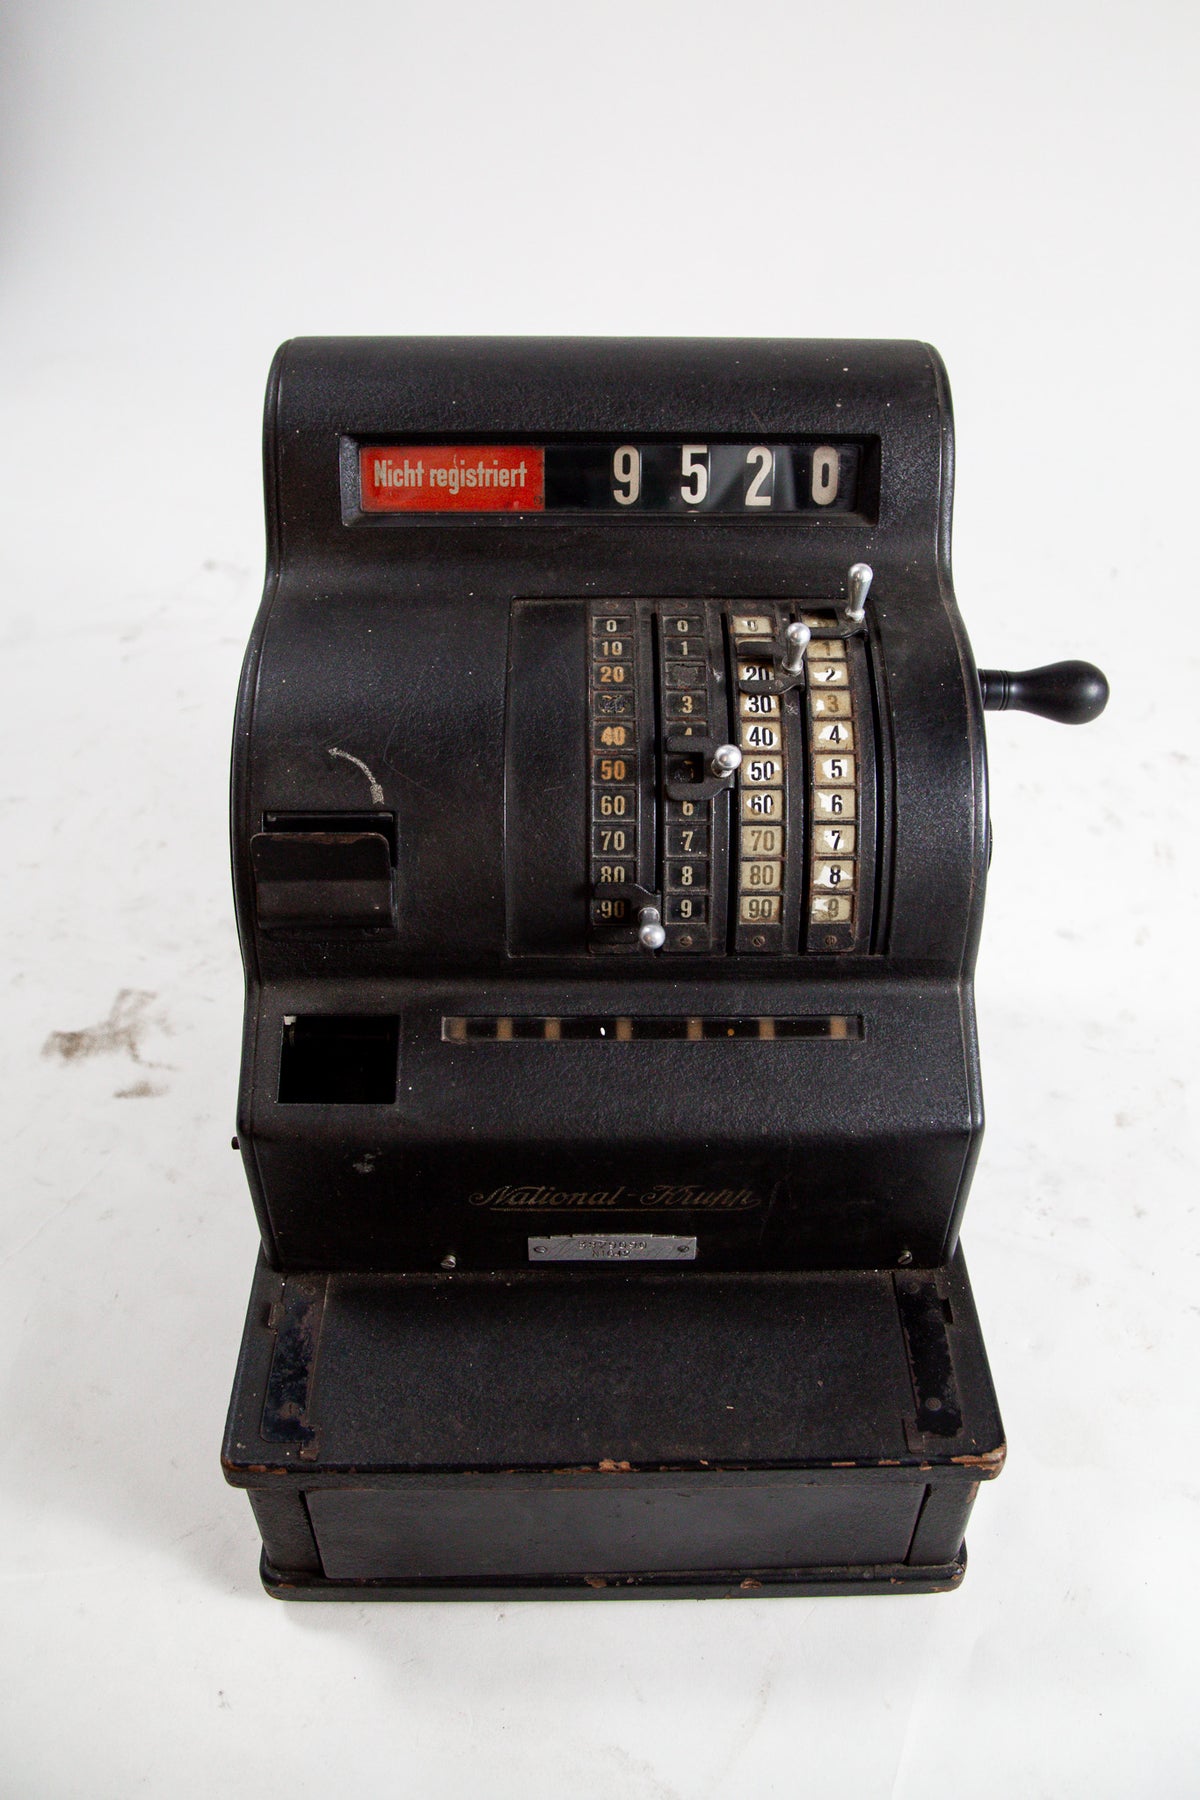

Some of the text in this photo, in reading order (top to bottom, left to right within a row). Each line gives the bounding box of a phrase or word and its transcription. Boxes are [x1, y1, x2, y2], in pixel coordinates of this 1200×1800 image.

[374, 459, 528, 494] Nicht registriert
[613, 445, 839, 506] 9 5 2 0
[606, 619, 617, 632] 0
[676, 619, 688, 632] 0
[601, 641, 623, 656] 10
[680, 640, 688, 656] 1
[600, 666, 624, 683] 20
[745, 666, 770, 681] 20
[825, 666, 837, 683] 2
[682, 695, 693, 714] 3
[748, 695, 772, 714] 30
[827, 695, 839, 713] 3
[600, 726, 626, 746] 40
[749, 727, 774, 747] 40
[829, 725, 841, 745] 4
[601, 760, 626, 780] 50
[750, 760, 775, 781] 50
[831, 759, 842, 780] 5
[600, 795, 626, 816] 60
[682, 801, 694, 816] 6
[750, 794, 775, 816] 60
[831, 794, 842, 816] 6
[600, 830, 626, 851] 70
[682, 831, 694, 851] 7
[750, 830, 775, 852] 70
[831, 830, 842, 850] 7
[681, 866, 693, 886] 8
[750, 864, 774, 886] 80
[829, 864, 841, 886] 8
[601, 900, 625, 919] 90
[680, 900, 692, 919] 9
[748, 898, 773, 919] 90
[828, 898, 839, 918] 9
